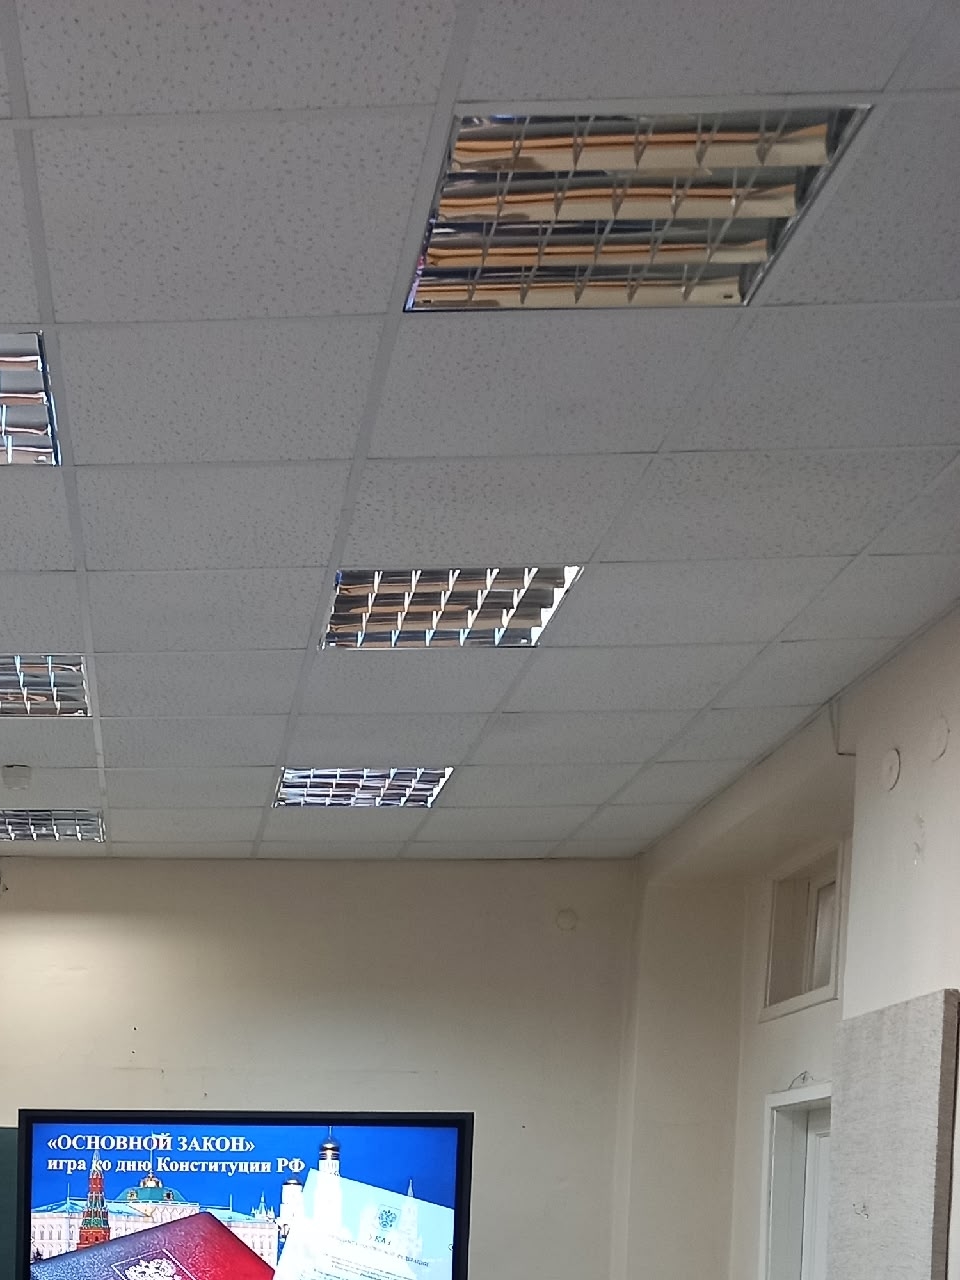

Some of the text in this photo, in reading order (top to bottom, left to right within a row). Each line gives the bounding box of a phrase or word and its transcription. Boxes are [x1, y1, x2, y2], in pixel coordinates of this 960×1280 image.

[47, 1132, 256, 1152] «ОСНОВНОЙ ЗАКОН»
[47, 1157, 306, 1176] игра ко дню Конституции РФ
